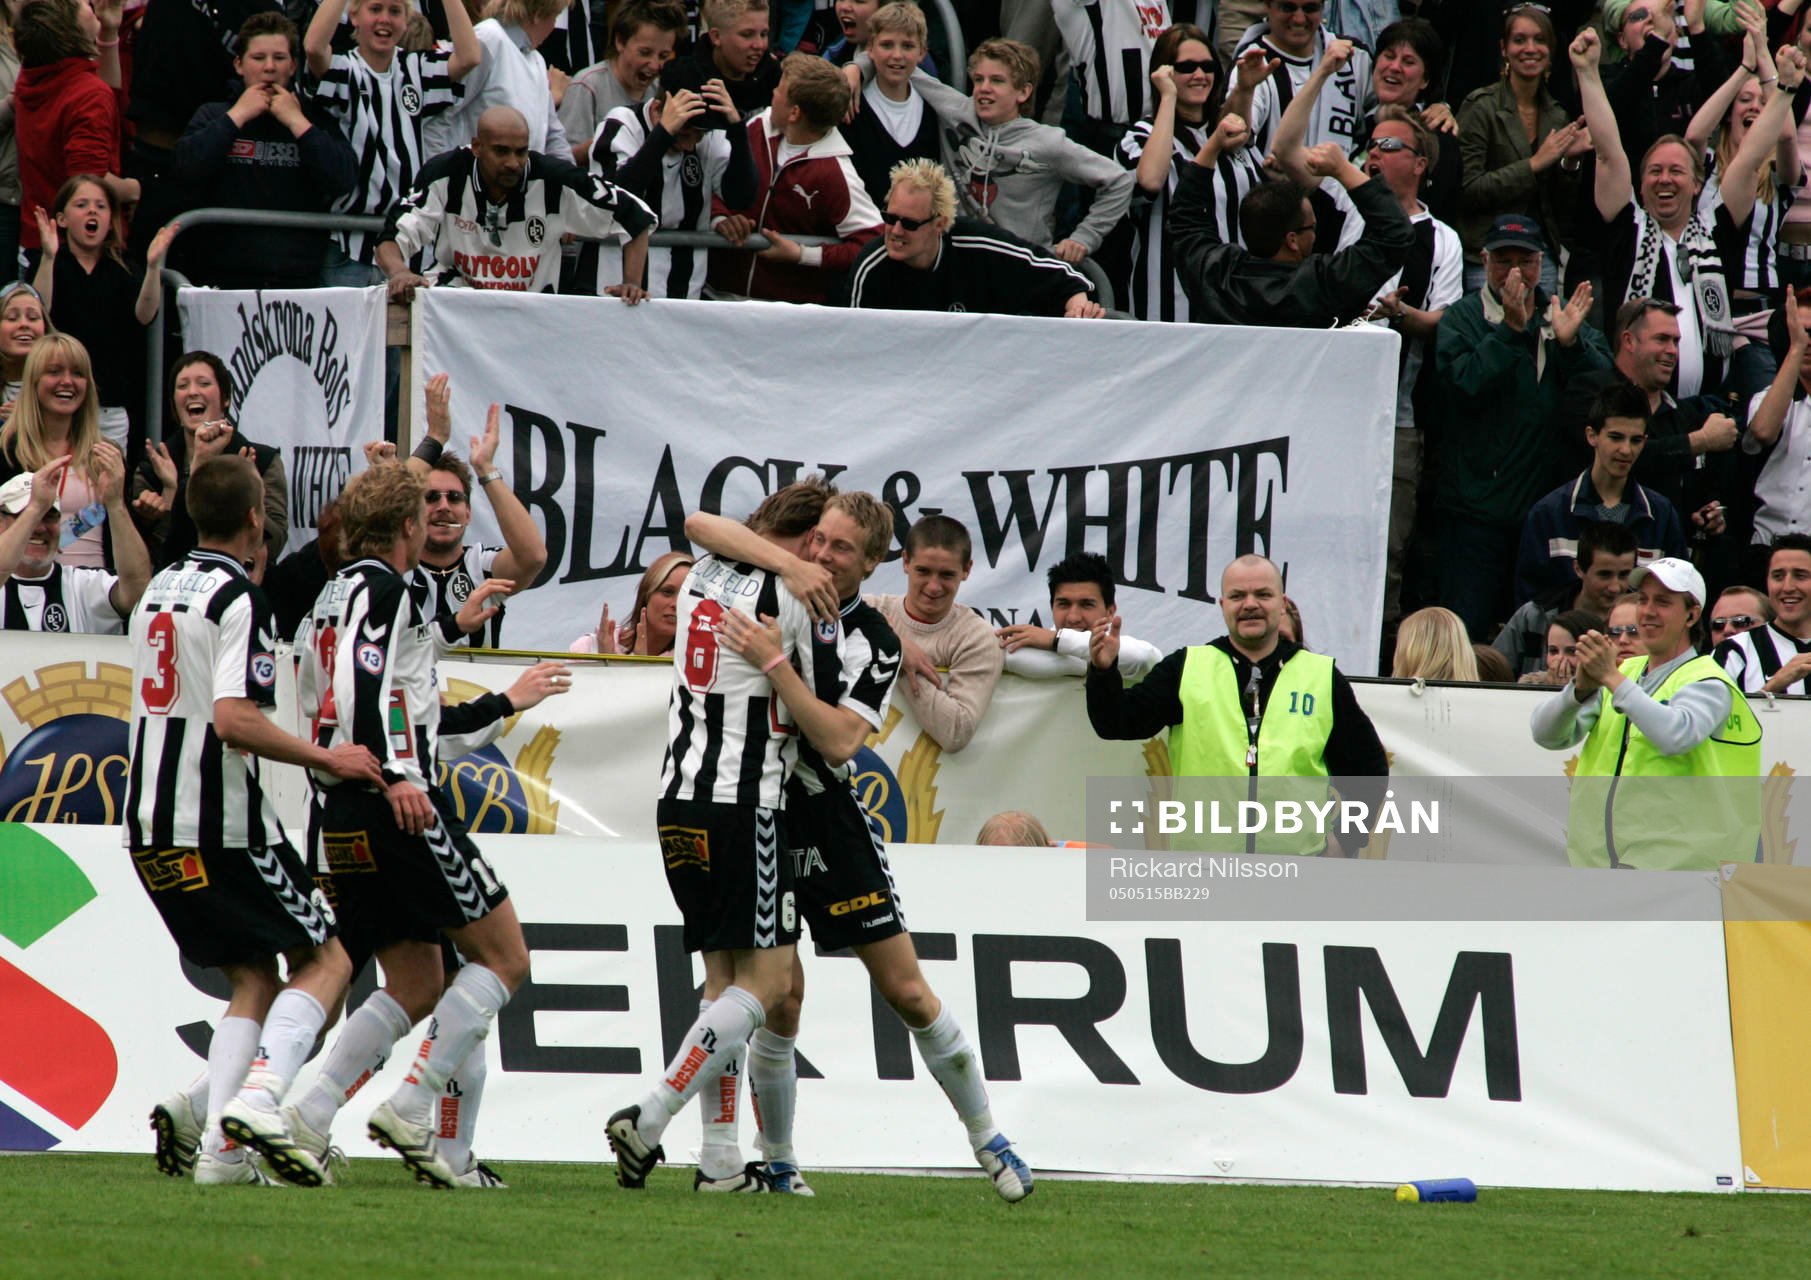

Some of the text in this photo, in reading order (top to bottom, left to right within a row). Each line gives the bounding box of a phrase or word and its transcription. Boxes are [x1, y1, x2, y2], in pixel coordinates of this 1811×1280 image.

[254, 141, 300, 162] DIESEL
[505, 404, 848, 591] BLAC
[961, 436, 1290, 604] WHITE
[968, 606, 1044, 631] NA
[140, 611, 181, 715] 3
[254, 660, 274, 678] 13
[362, 650, 381, 668] 13
[1289, 691, 1315, 716] 10
[786, 846, 829, 878] TA
[781, 891, 797, 933] 6
[829, 890, 887, 917] GDL
[861, 912, 894, 929] hummel
[175, 921, 1522, 1102] ETRUM
[665, 1045, 710, 1094] besam
[713, 1075, 738, 1124] besam
